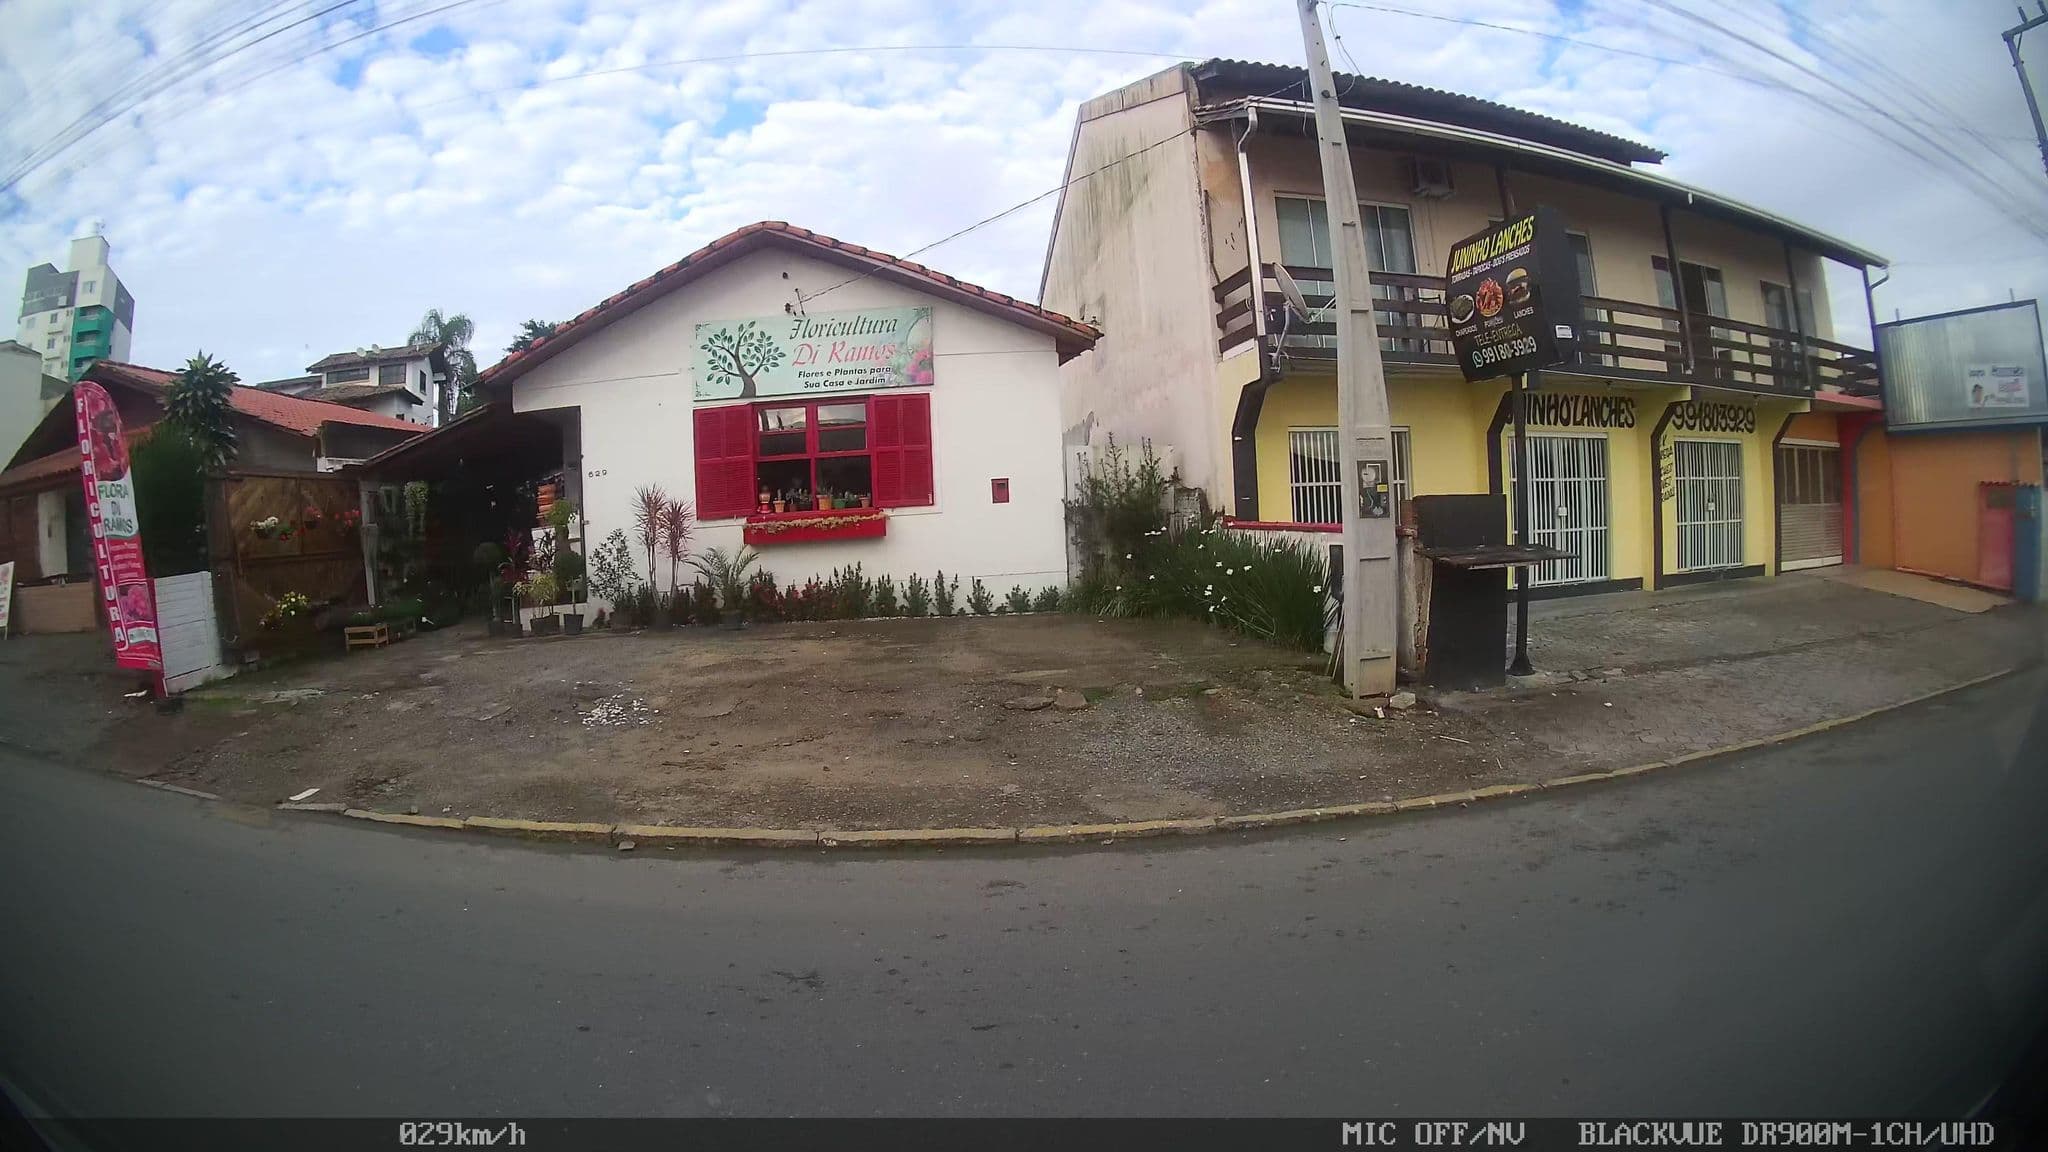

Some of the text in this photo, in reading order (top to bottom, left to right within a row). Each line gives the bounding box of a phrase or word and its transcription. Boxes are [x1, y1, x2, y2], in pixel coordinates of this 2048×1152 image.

[1451, 215, 1535, 274] JUNINHO LANCHES
[1513, 306, 1534, 319] LANCHES
[789, 315, 898, 340] Floricultura
[792, 341, 896, 367] Di Ramos
[798, 371, 824, 379] Flores
[834, 368, 867, 376] Plantas
[869, 366, 891, 375] para
[804, 381, 821, 389] Sua
[823, 379, 845, 388] Casa
[855, 376, 886, 386] Jardim
[1672, 403, 1757, 434] 991803929
[97, 483, 129, 500] FLORA
[111, 501, 121, 516] DI
[77, 397, 125, 643] FLORICULTURA
[104, 518, 134, 534] RAMOS
